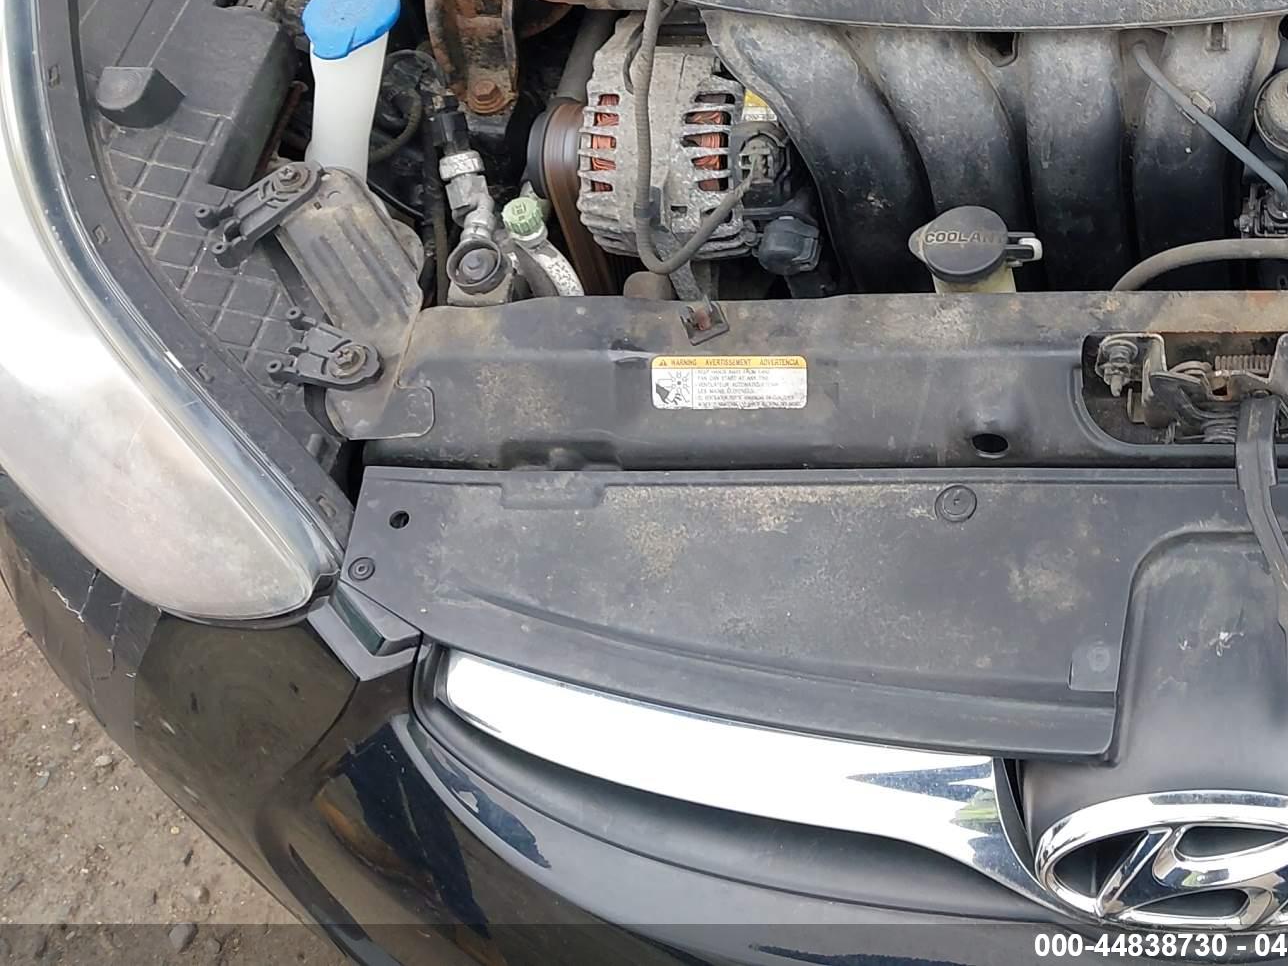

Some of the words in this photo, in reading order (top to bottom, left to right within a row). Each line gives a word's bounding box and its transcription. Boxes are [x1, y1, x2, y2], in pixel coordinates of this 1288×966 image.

[671, 358, 697, 366] WARNING
[705, 358, 751, 366] AVERTISSEMENT
[759, 358, 800, 366] ADVERTENCIA
